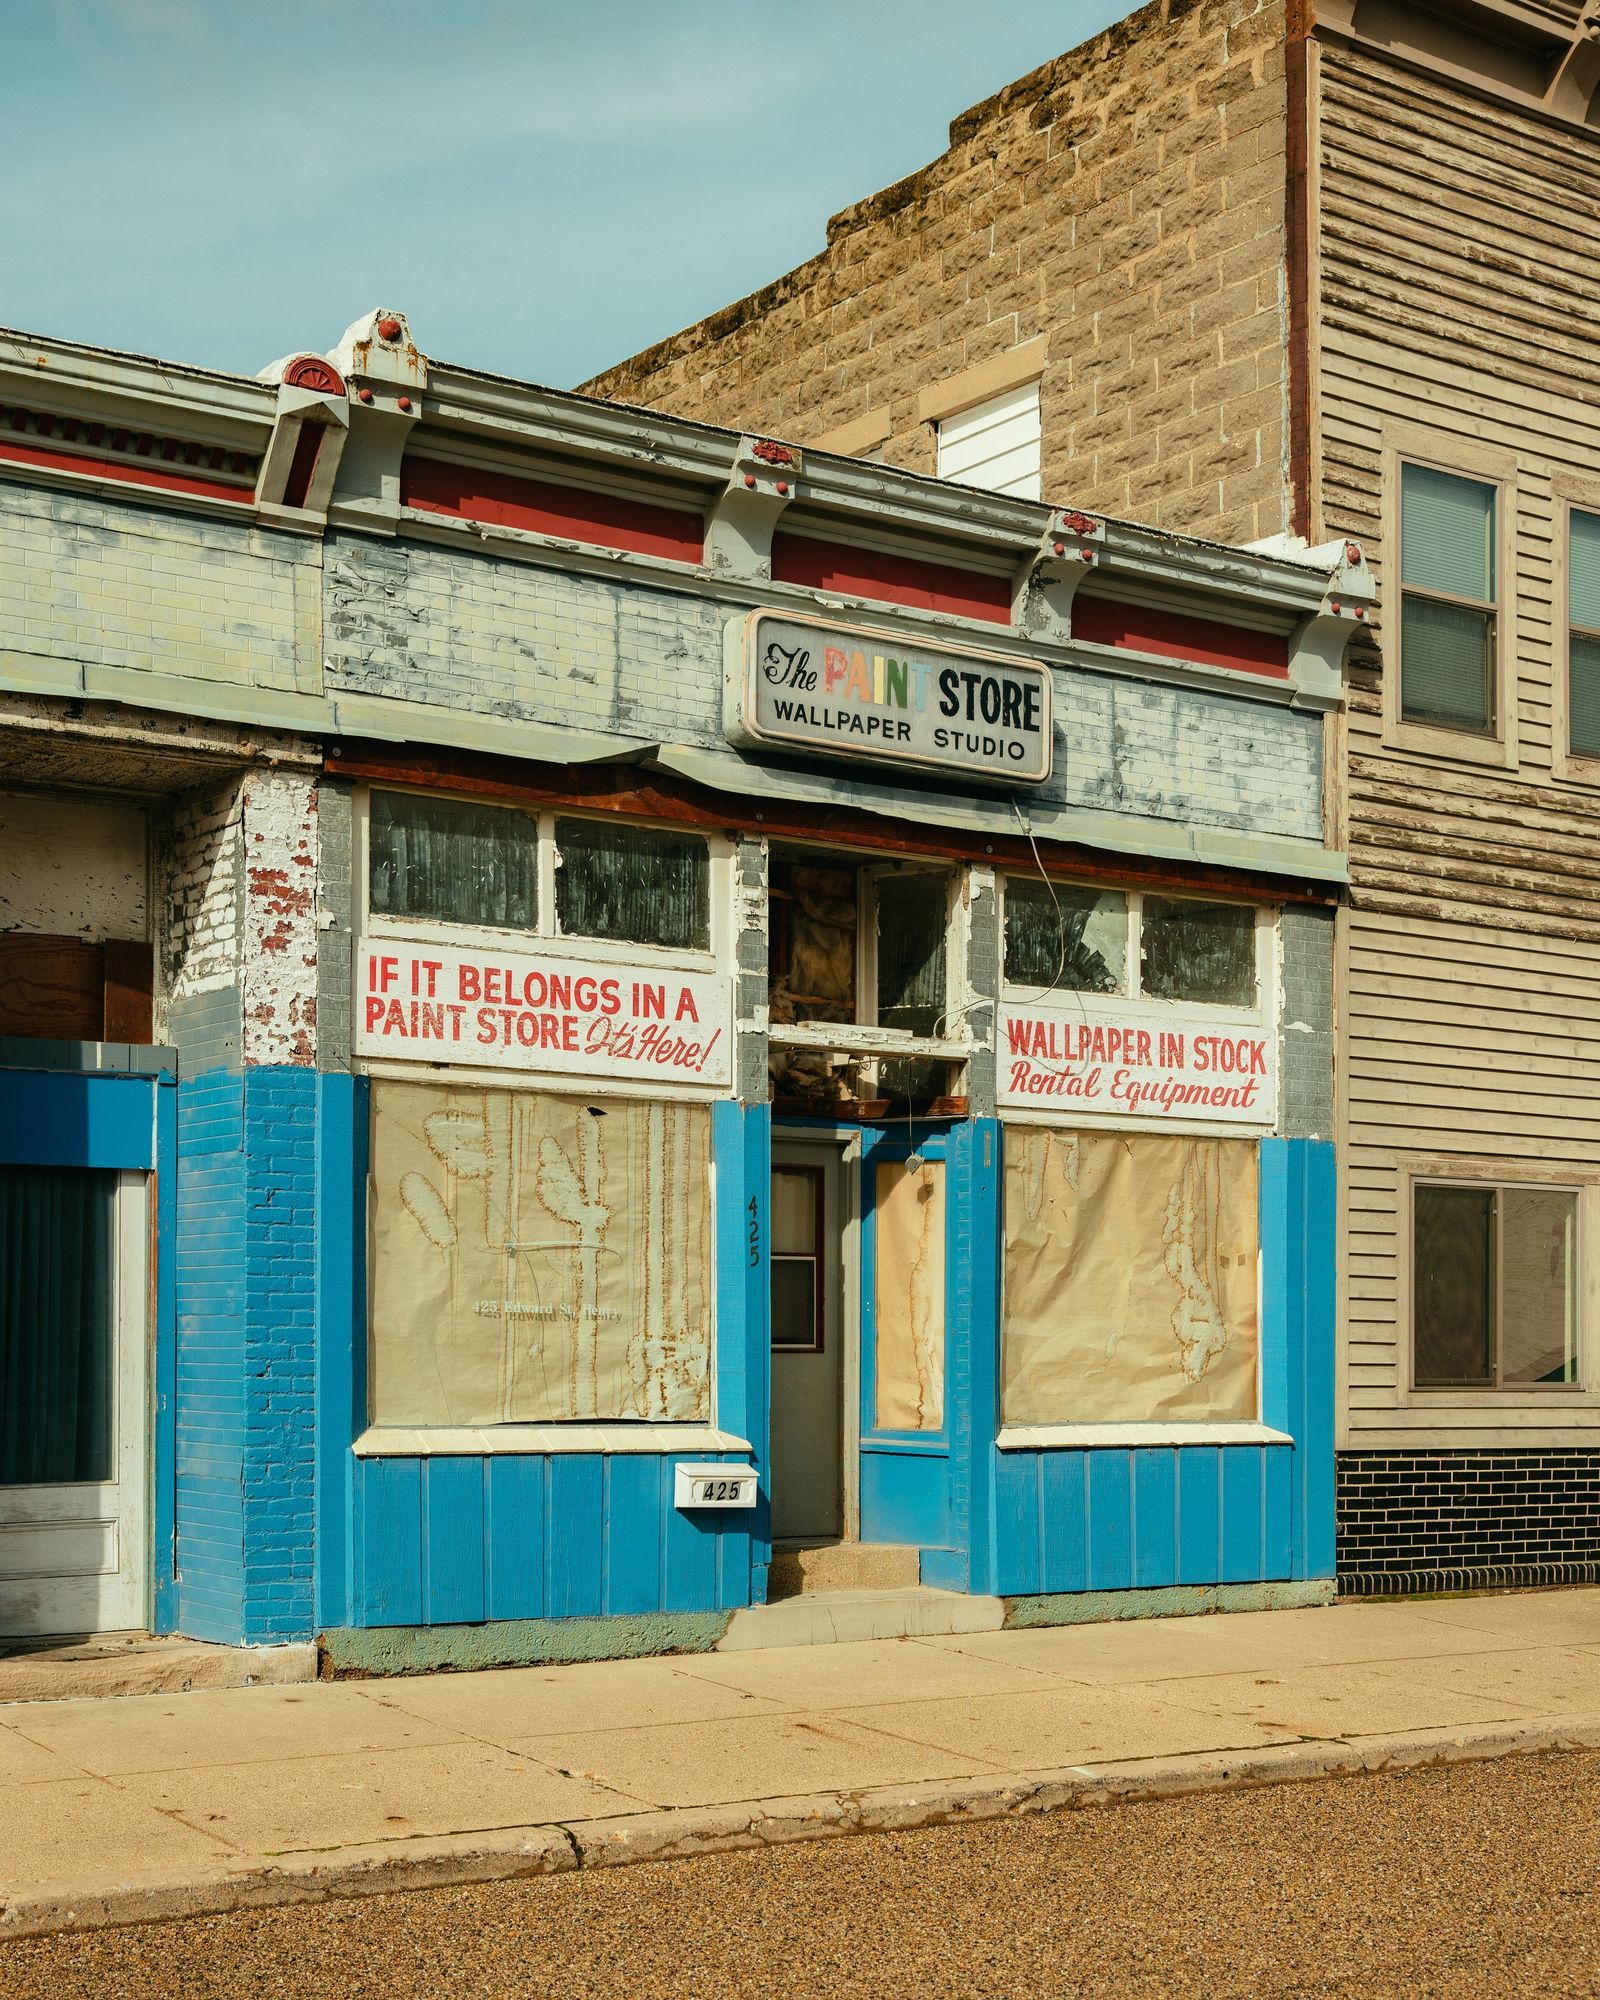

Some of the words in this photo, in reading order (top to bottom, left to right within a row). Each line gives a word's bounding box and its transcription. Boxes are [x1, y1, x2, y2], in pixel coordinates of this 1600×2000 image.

[762, 642, 818, 692] The
[822, 646, 931, 713] PAINT
[938, 668, 1040, 733] STORE
[774, 699, 912, 743] WALLPAPER
[934, 728, 1025, 761] STUDIO
[369, 955, 399, 993] IF
[411, 959, 442, 998] IT
[458, 964, 621, 1015] BELONGS
[632, 982, 666, 1020] IN
[674, 987, 700, 1023] A
[365, 996, 467, 1041] PAINT
[476, 1007, 580, 1052] STORE
[585, 1016, 637, 1060] It's
[631, 1024, 722, 1073] Here!
[1007, 1018, 1152, 1067] WALLPAPER
[1159, 1032, 1184, 1070] IN
[1193, 1036, 1267, 1075] STOCK
[1008, 1060, 1102, 1098] Rental
[1110, 1068, 1259, 1112] Equipment
[748, 1195, 760, 1268] 425
[472, 1301, 497, 1313] 425
[504, 1302, 553, 1315] Edward
[582, 1303, 619, 1317] Henry
[704, 1482, 740, 1501] 425
